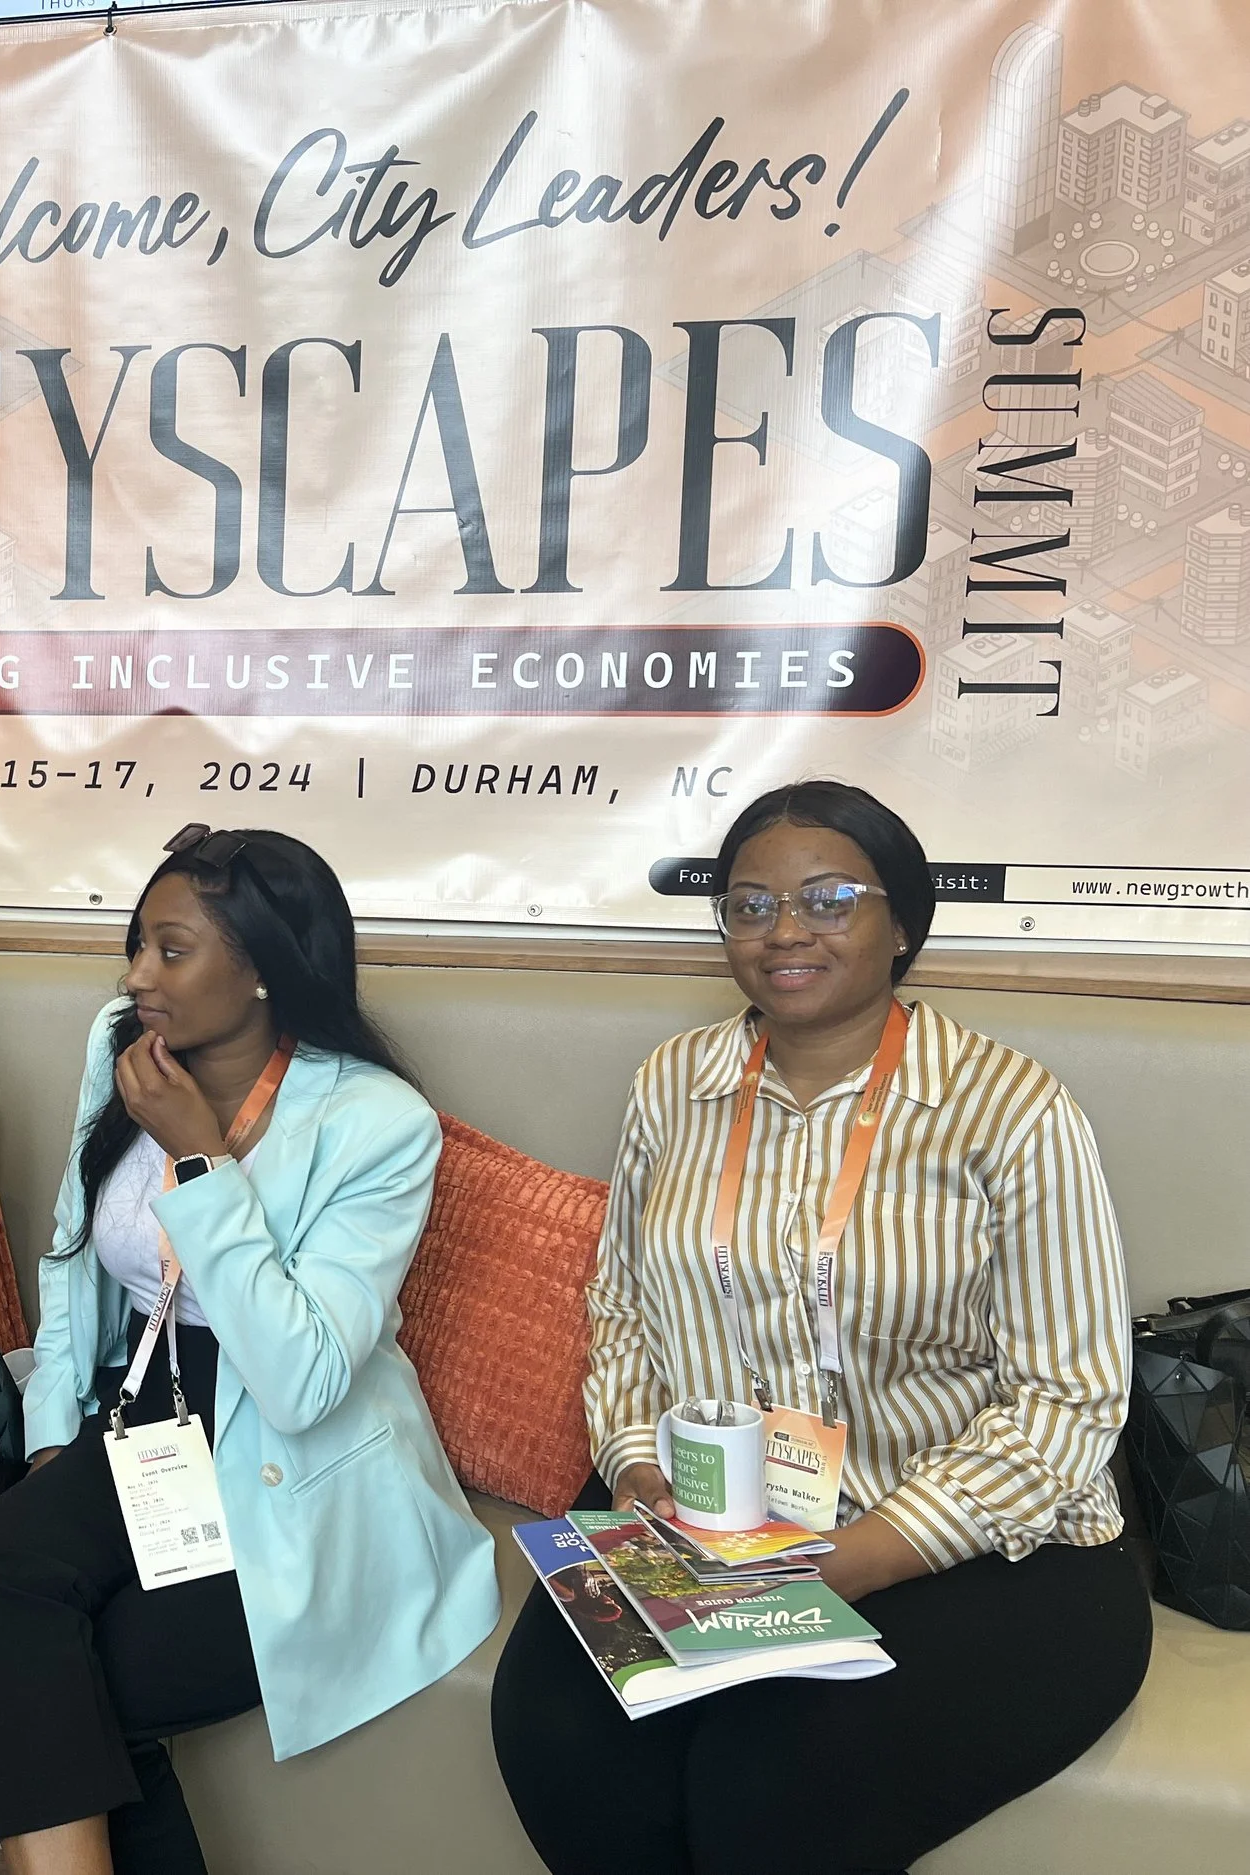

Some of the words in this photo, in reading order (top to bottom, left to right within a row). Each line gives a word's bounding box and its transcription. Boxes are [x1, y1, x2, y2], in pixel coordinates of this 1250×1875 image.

[253, 127, 456, 287] City
[461, 87, 911, 250] Leaders!
[958, 307, 1086, 717] SUMMIT
[72, 653, 415, 690] INCLUSIVE
[471, 648, 857, 690] ECONOMIES
[200, 762, 312, 792] 2024
[411, 763, 620, 804] DURHAM,
[671, 765, 734, 797] NC
[679, 869, 713, 884] For
[931, 874, 991, 891] isit:
[717, 1245, 732, 1296] CITYSCAPES
[817, 1255, 829, 1307] CITYSCAPES
[701, 1453, 715, 1465] to
[766, 1439, 822, 1469] ITYSCAPES
[766, 1482, 788, 1494] rysha
[792, 1489, 821, 1504] Walker
[695, 1598, 733, 1606] GUIDE
[736, 1595, 784, 1604] VISITOR
[685, 1606, 833, 1634] DURHAM
[752, 1624, 825, 1638] DISCOVER
